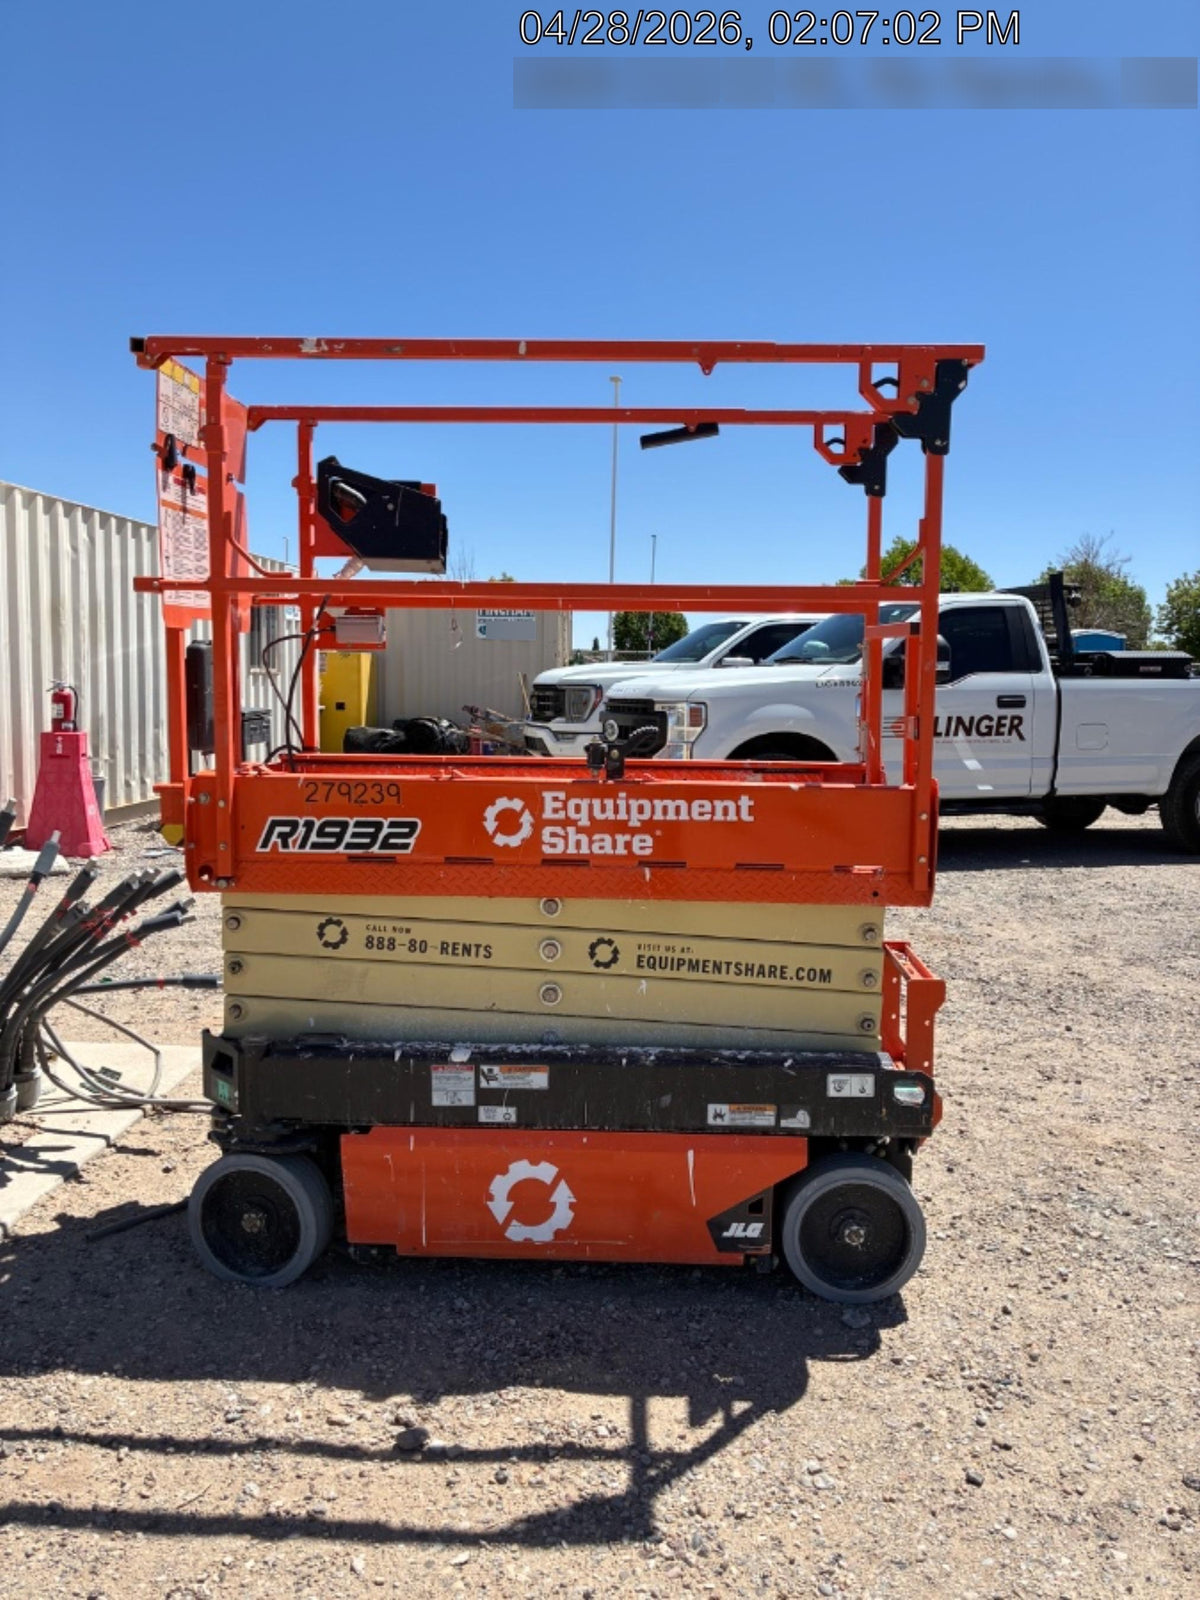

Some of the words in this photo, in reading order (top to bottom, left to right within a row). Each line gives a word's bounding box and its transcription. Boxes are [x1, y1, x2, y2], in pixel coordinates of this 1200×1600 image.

[304, 781, 401, 805] 279239
[541, 791, 754, 827] Equipment
[255, 816, 422, 854] R1932
[541, 826, 654, 856] Share
[365, 924, 388, 933] CALL
[391, 926, 412, 935] NOW
[364, 934, 494, 959] 888-80-RENTS
[637, 943, 661, 952] VISIT
[664, 945, 677, 954] US
[635, 954, 833, 984] EQUIPMENTSHARE.COM
[722, 1222, 766, 1238] JLG
